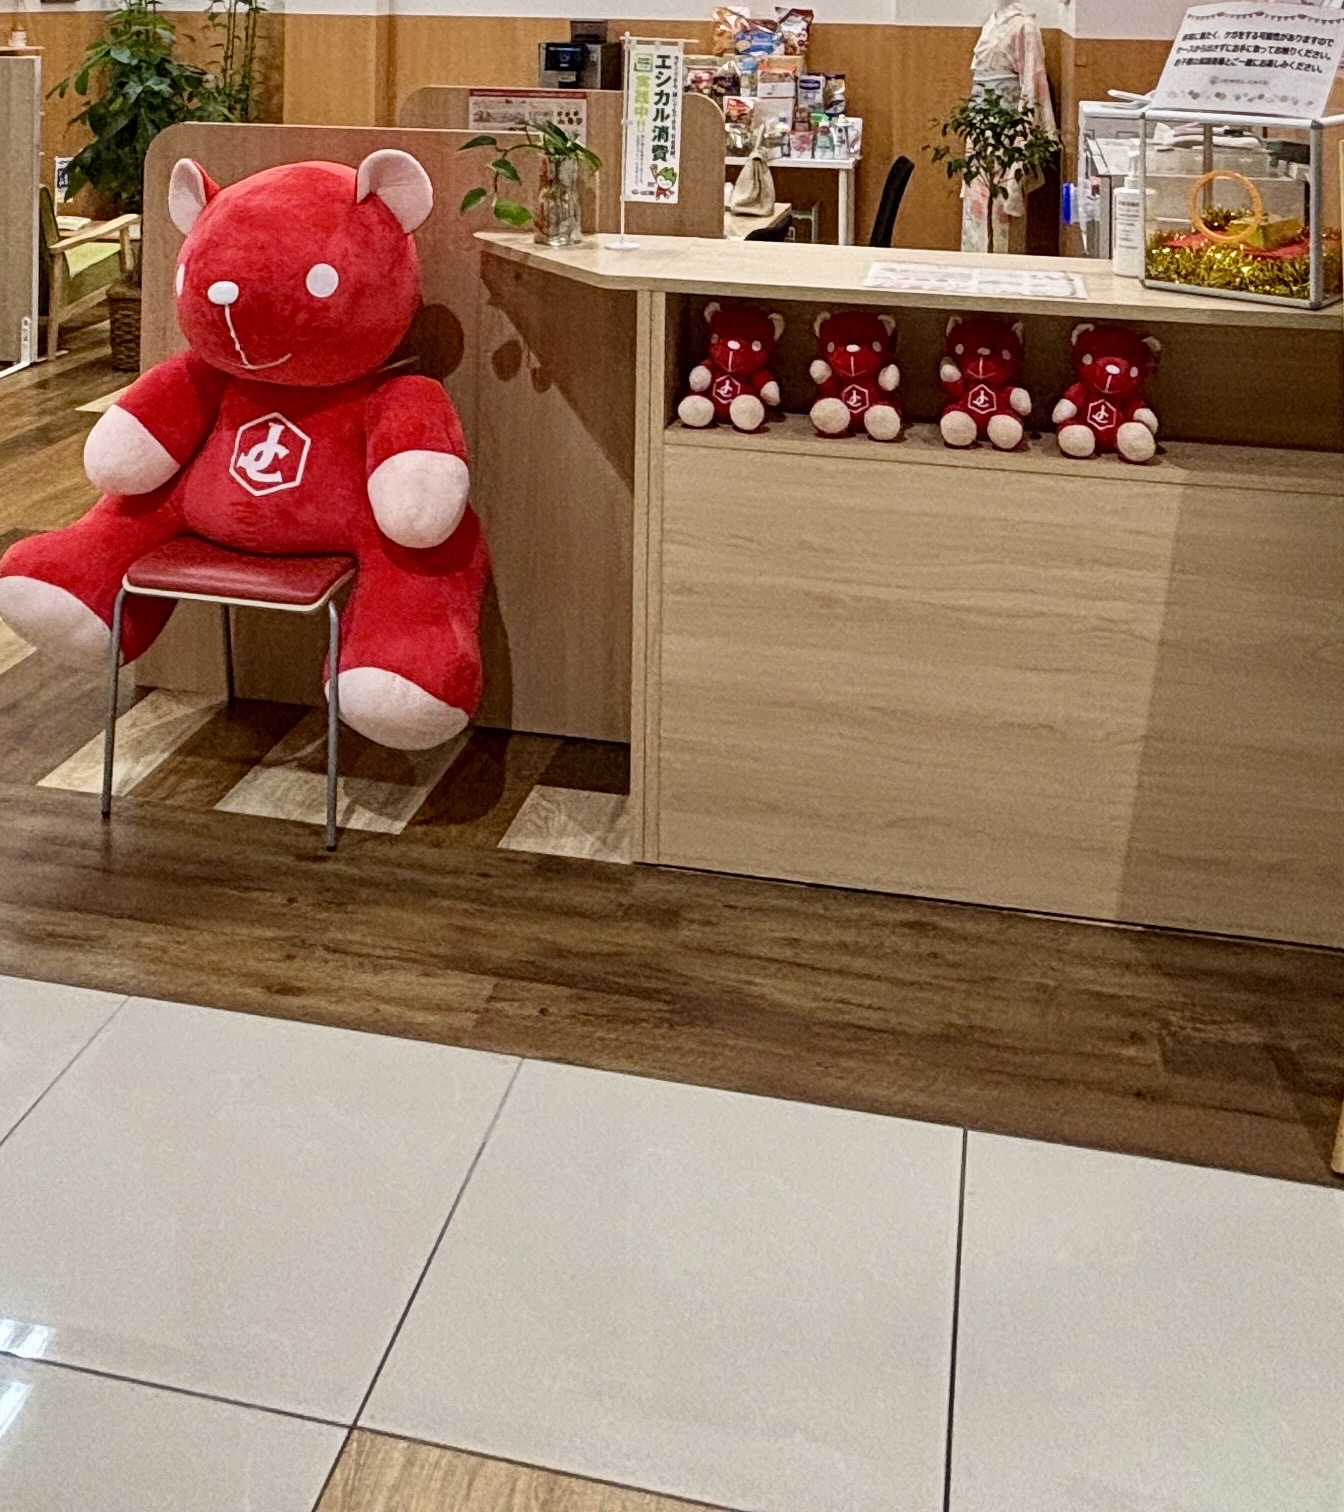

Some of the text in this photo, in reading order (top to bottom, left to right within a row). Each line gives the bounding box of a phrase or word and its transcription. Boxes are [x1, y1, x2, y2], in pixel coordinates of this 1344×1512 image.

[652, 54, 672, 162] エシカル消費
